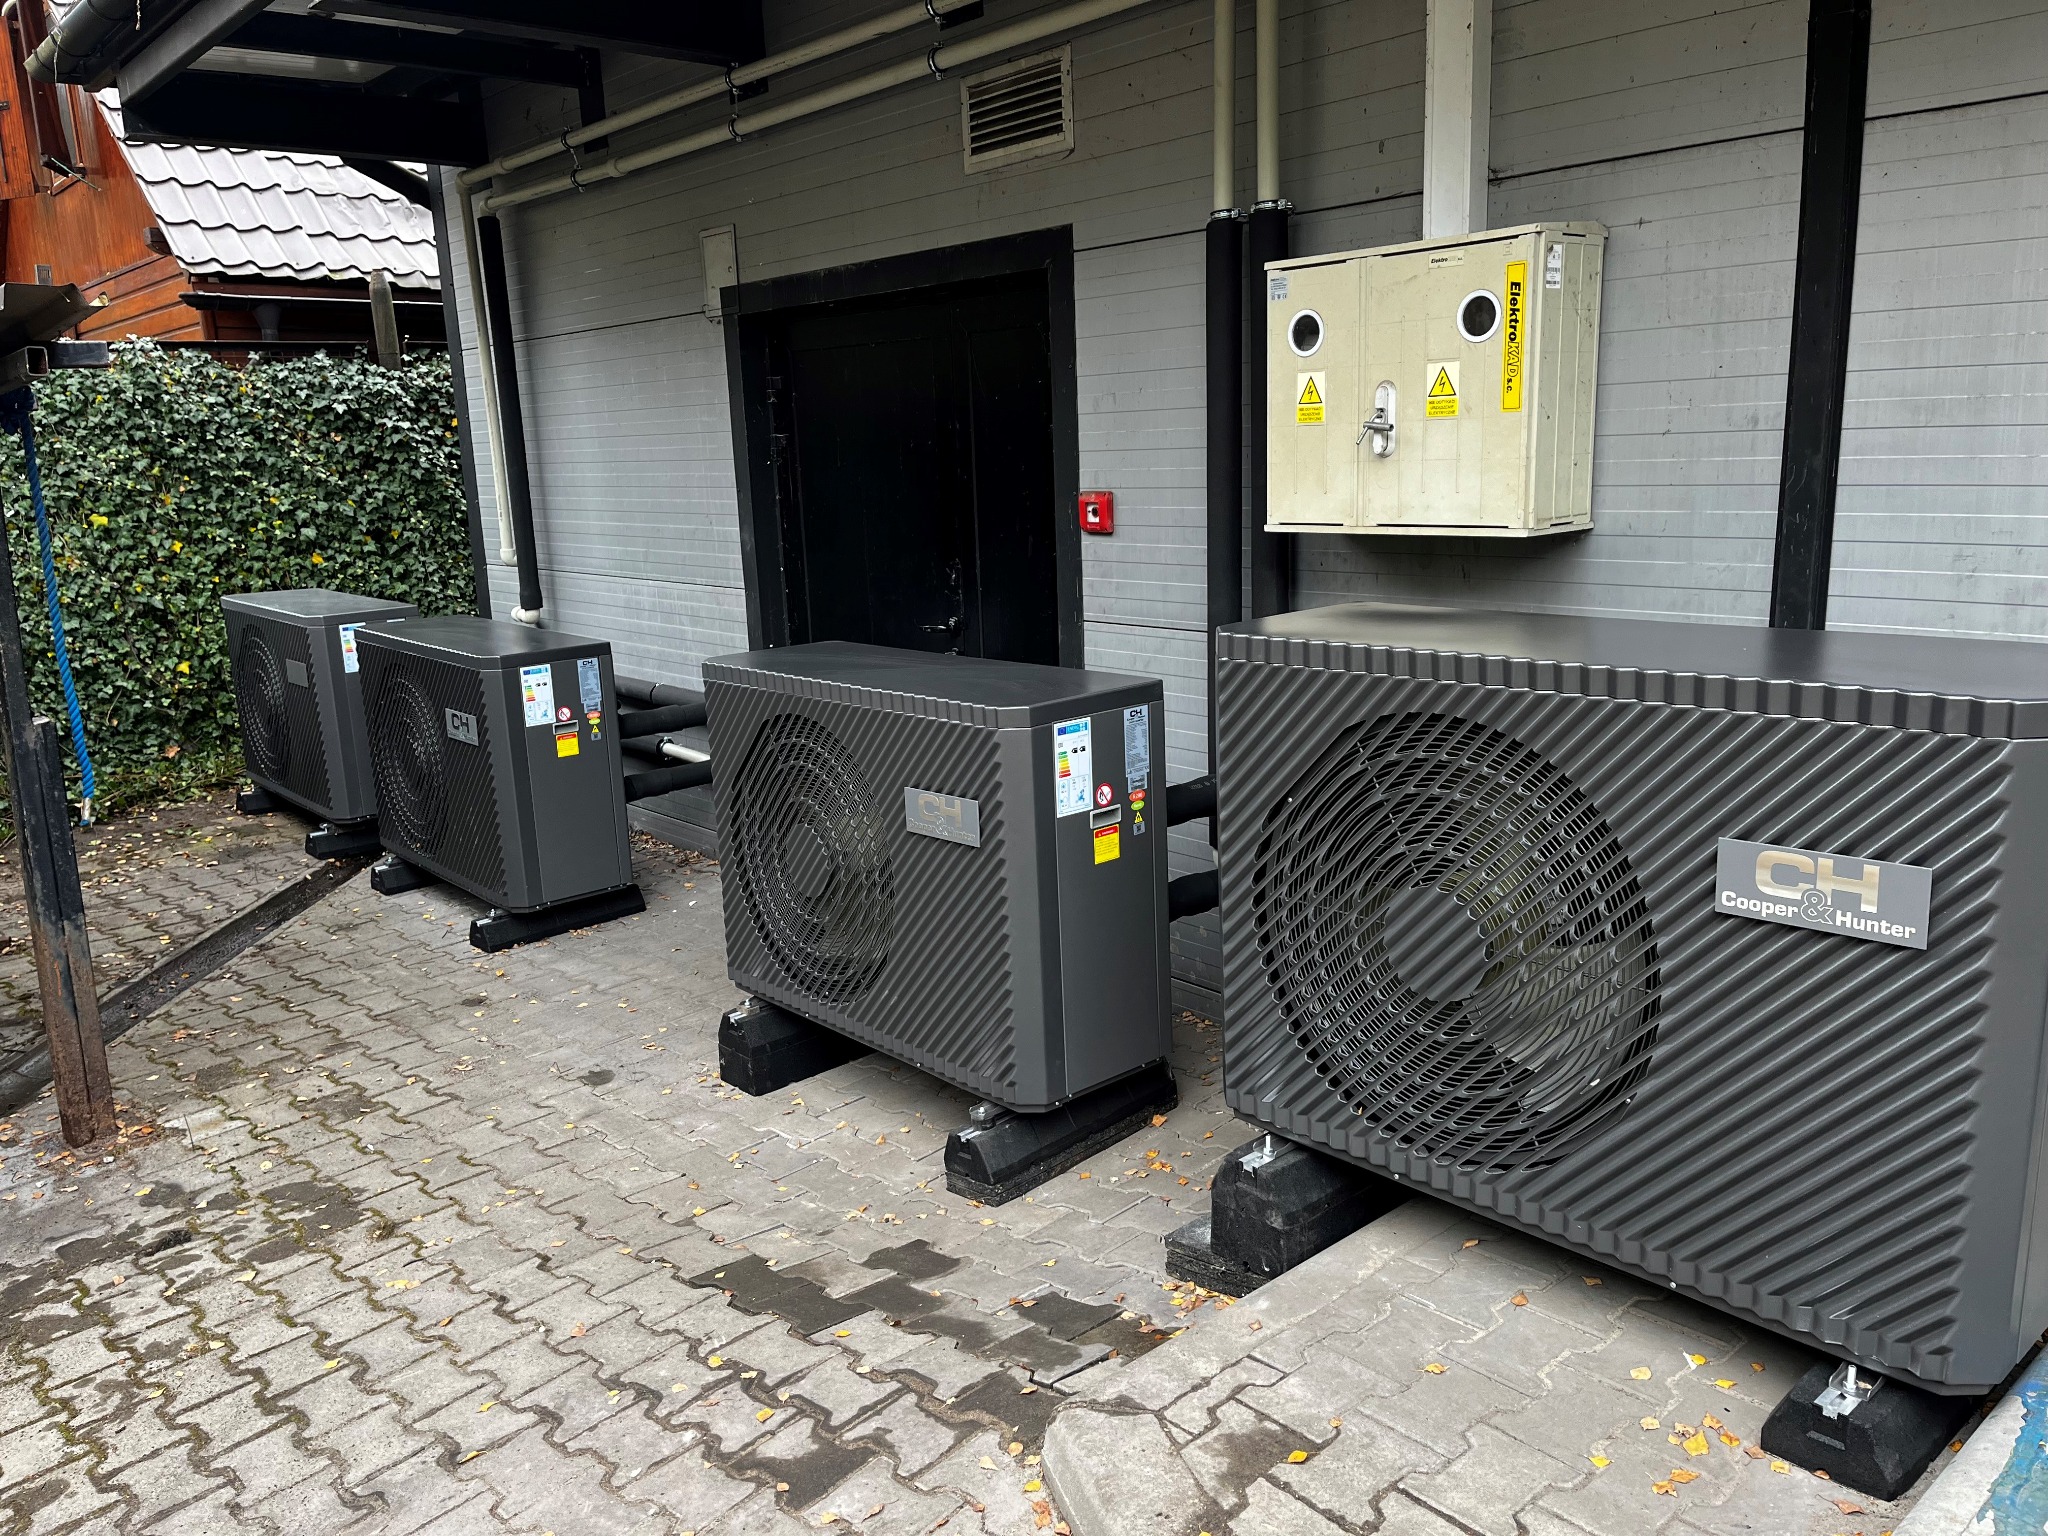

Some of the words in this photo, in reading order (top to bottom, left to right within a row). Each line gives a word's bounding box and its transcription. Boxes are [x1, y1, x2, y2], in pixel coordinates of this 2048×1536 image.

[1507, 281, 1521, 377] ElektroKAD
[451, 712, 470, 733] CH
[1130, 708, 1142, 717] CH
[918, 794, 961, 828] CH
[1755, 850, 1880, 914] CH
